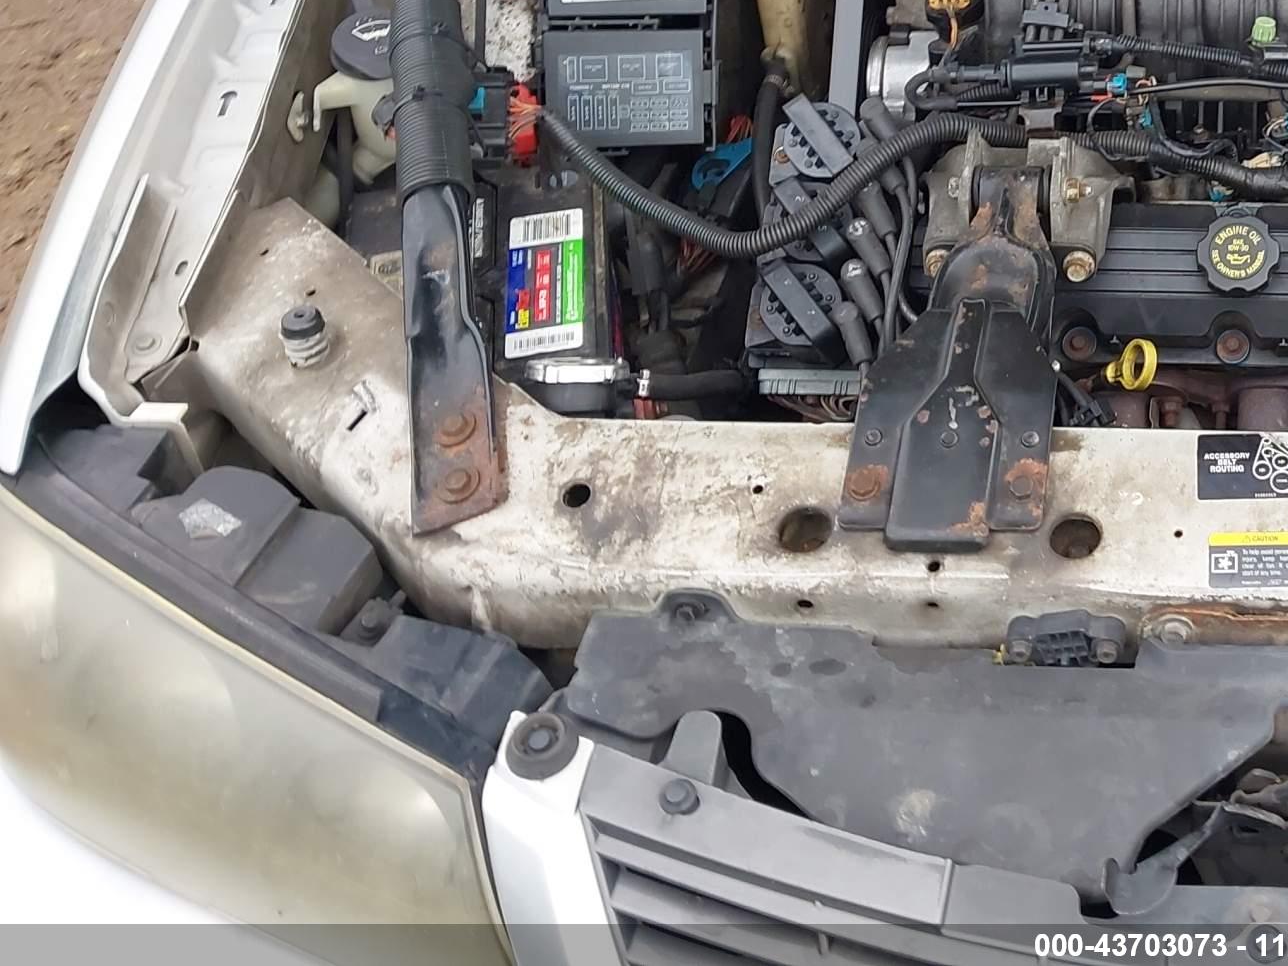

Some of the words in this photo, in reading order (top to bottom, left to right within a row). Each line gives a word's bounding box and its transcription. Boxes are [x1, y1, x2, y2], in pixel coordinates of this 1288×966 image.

[1215, 225, 1249, 245] ENGINE
[1249, 231, 1262, 245] OIL
[1203, 452, 1250, 460] ACCESSORY
[1209, 465, 1245, 473] ROUTING
